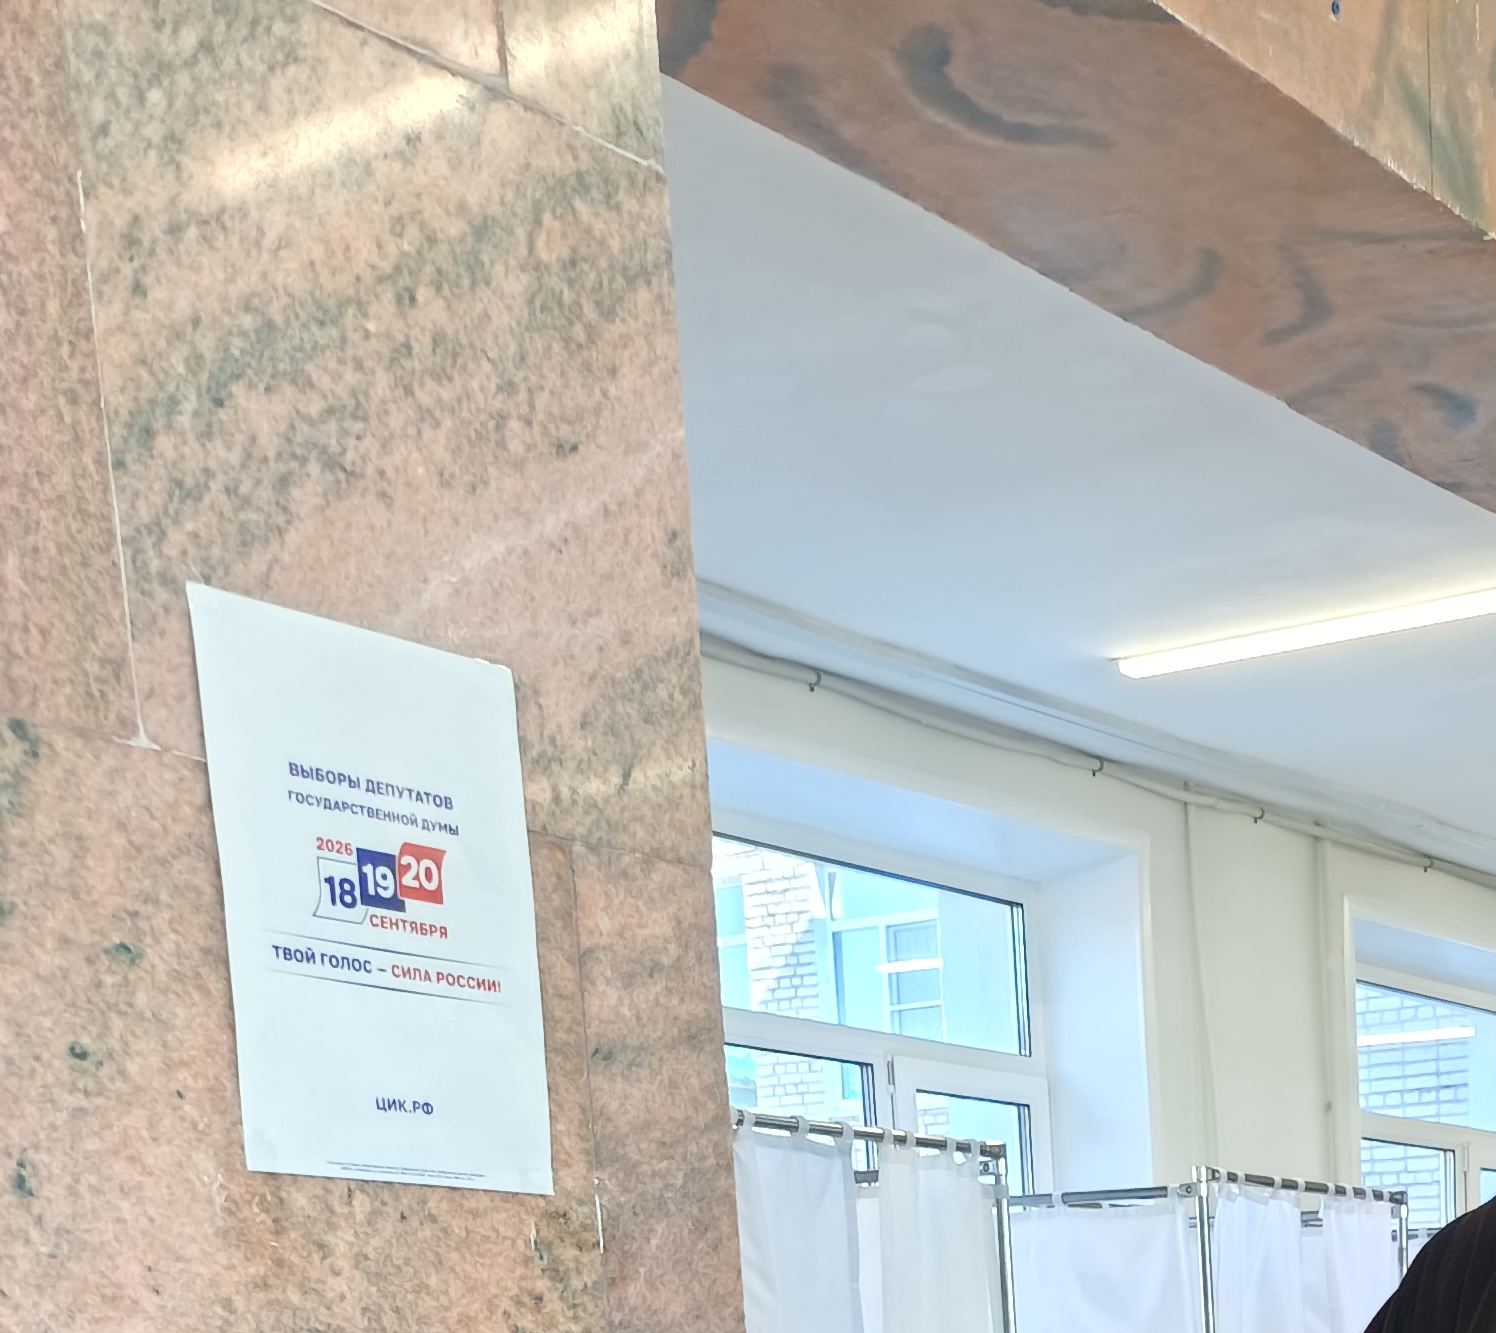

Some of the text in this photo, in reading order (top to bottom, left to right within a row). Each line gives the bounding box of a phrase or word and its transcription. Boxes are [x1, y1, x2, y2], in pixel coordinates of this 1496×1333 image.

[288, 761, 454, 811] ВЫБОРЫ ДЕПУТАТОВ
[288, 789, 460, 837] ГОСУДАРСТВЕННОЙ ДУМЫ
[316, 836, 354, 857] 2026
[323, 855, 440, 909] 18 19 20
[369, 913, 448, 939] СЕНТЯБРЯ
[272, 944, 316, 965] ТВОЙ
[320, 952, 372, 974] ГОЛОС
[391, 963, 433, 983] СИЛА
[436, 971, 502, 993] РОССИИ!
[375, 1096, 434, 1116] ЦИК.РФ
